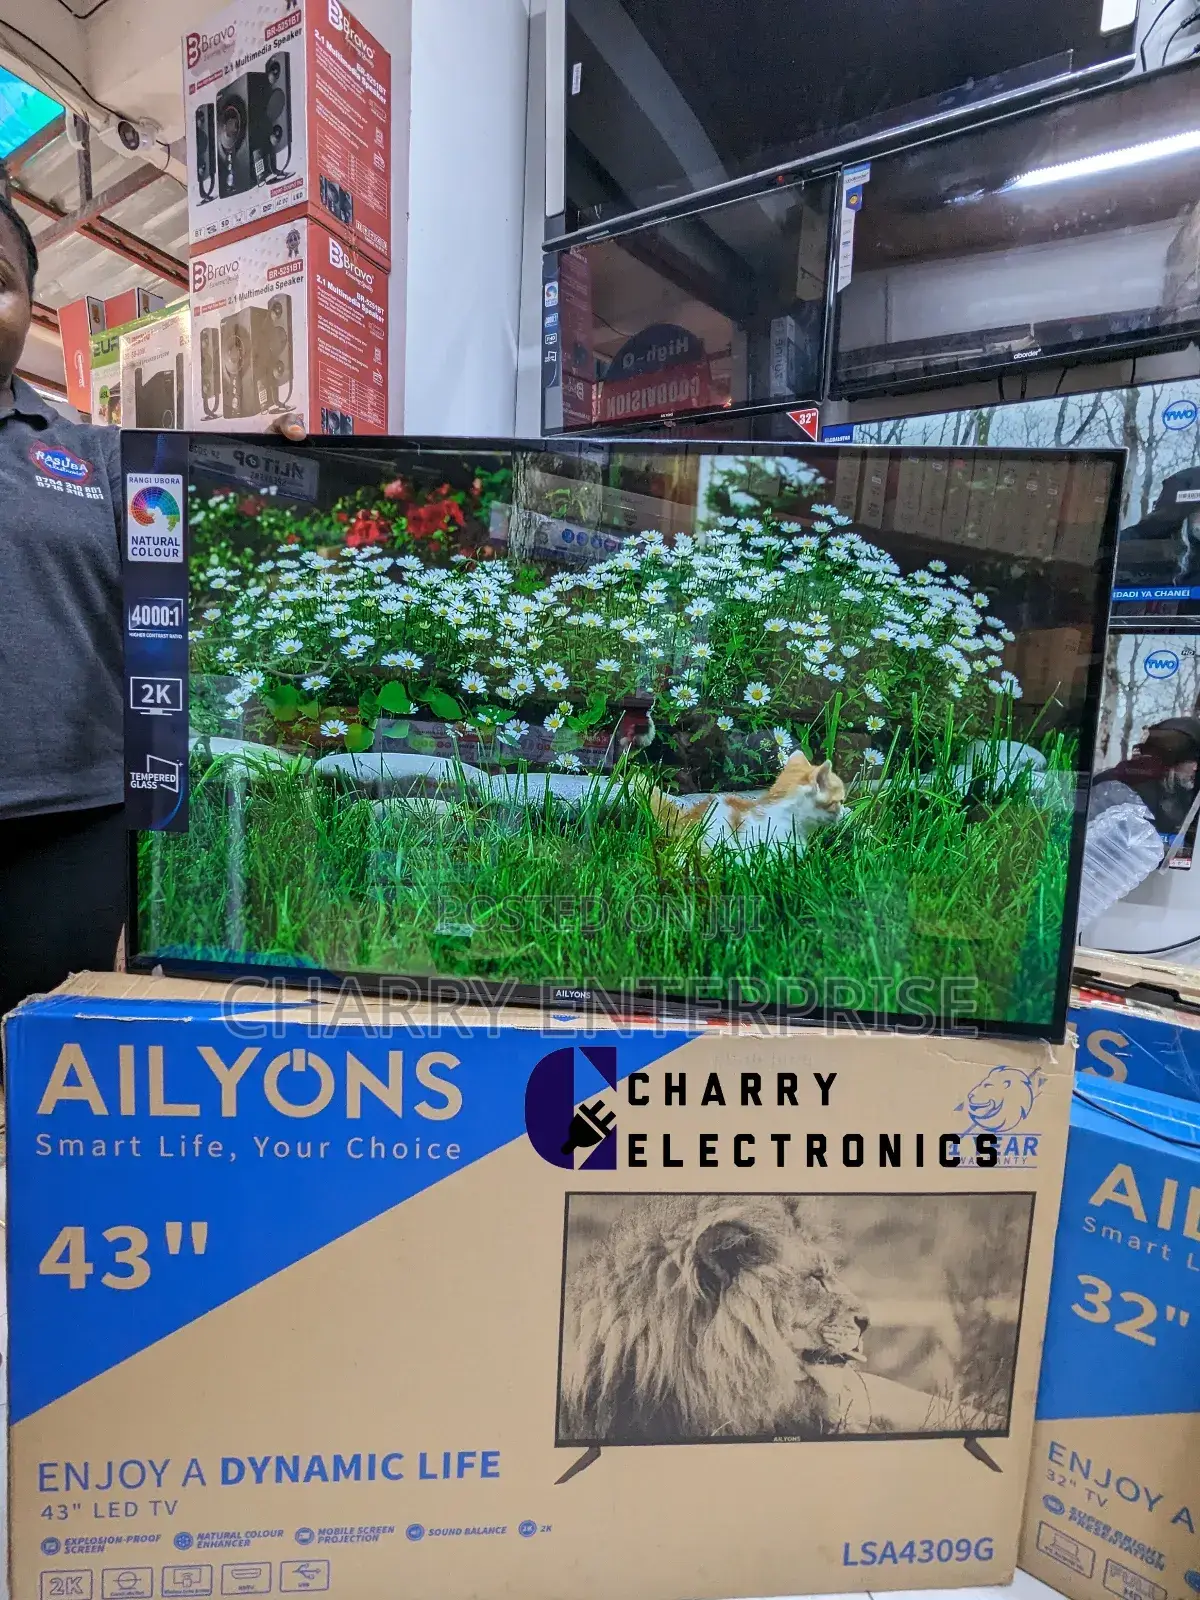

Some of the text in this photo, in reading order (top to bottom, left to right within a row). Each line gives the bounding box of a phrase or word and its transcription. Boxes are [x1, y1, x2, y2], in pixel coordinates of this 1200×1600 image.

[201, 25, 235, 48] Bravo
[344, 15, 374, 59] Bravo
[224, 62, 234, 75] 2.1
[235, 42, 272, 68] Multimedia
[273, 28, 303, 48] Speaker
[207, 260, 240, 281] Bravo
[268, 262, 303, 280] BR-5251BT
[343, 254, 373, 285] Bravo
[228, 275, 304, 305] 2.1 Multimedia Speaker
[316, 274, 326, 286] 2.1
[327, 281, 361, 308] Multimedia
[361, 304, 384, 324] Speaker
[799, 412, 816, 425] 32"
[1166, 409, 1194, 421] TWO
[154, 477, 180, 485] UBORA
[131, 536, 180, 547] NATURAL
[131, 547, 179, 557] COLOUR
[131, 605, 179, 627] 4000:1
[1147, 659, 1176, 669] TWO
[141, 683, 172, 704] 2K
[130, 771, 176, 783] TEMPERED
[130, 780, 158, 790] GLASS
[555, 990, 591, 999] AILYONS
[36, 1043, 463, 1121] AILYONS
[36, 1134, 462, 1162] Smart Life, Your Choice
[1082, 1216, 1171, 1261] Smart
[39, 1221, 209, 1290] 43"
[1071, 1274, 1190, 1347] 32"
[38, 1450, 500, 1492] ENJOY A DYNAMIC LIFE
[1046, 1468, 1109, 1507] 32" TV
[1048, 1440, 1195, 1534] ENJOY A
[41, 1500, 179, 1520] 43" LED TV
[64, 1533, 162, 1546] EXPLOSION-PROOF
[197, 1529, 284, 1541] NATURAL COLOUR
[317, 1526, 395, 1535] MOBILE SCREEN
[317, 1534, 380, 1544] PROJECTION
[428, 1526, 508, 1536] SOUND BALANCE
[540, 1525, 552, 1533] 2K
[1069, 1506, 1112, 1533] SUPER
[1114, 1529, 1166, 1561] BRIGHT
[63, 1544, 106, 1555] SCREEN
[197, 1539, 251, 1549] ENHANCER
[843, 1537, 995, 1567] LSA4309G
[1068, 1514, 1164, 1571] PRESENTATION
[49, 1576, 84, 1597] 2K
